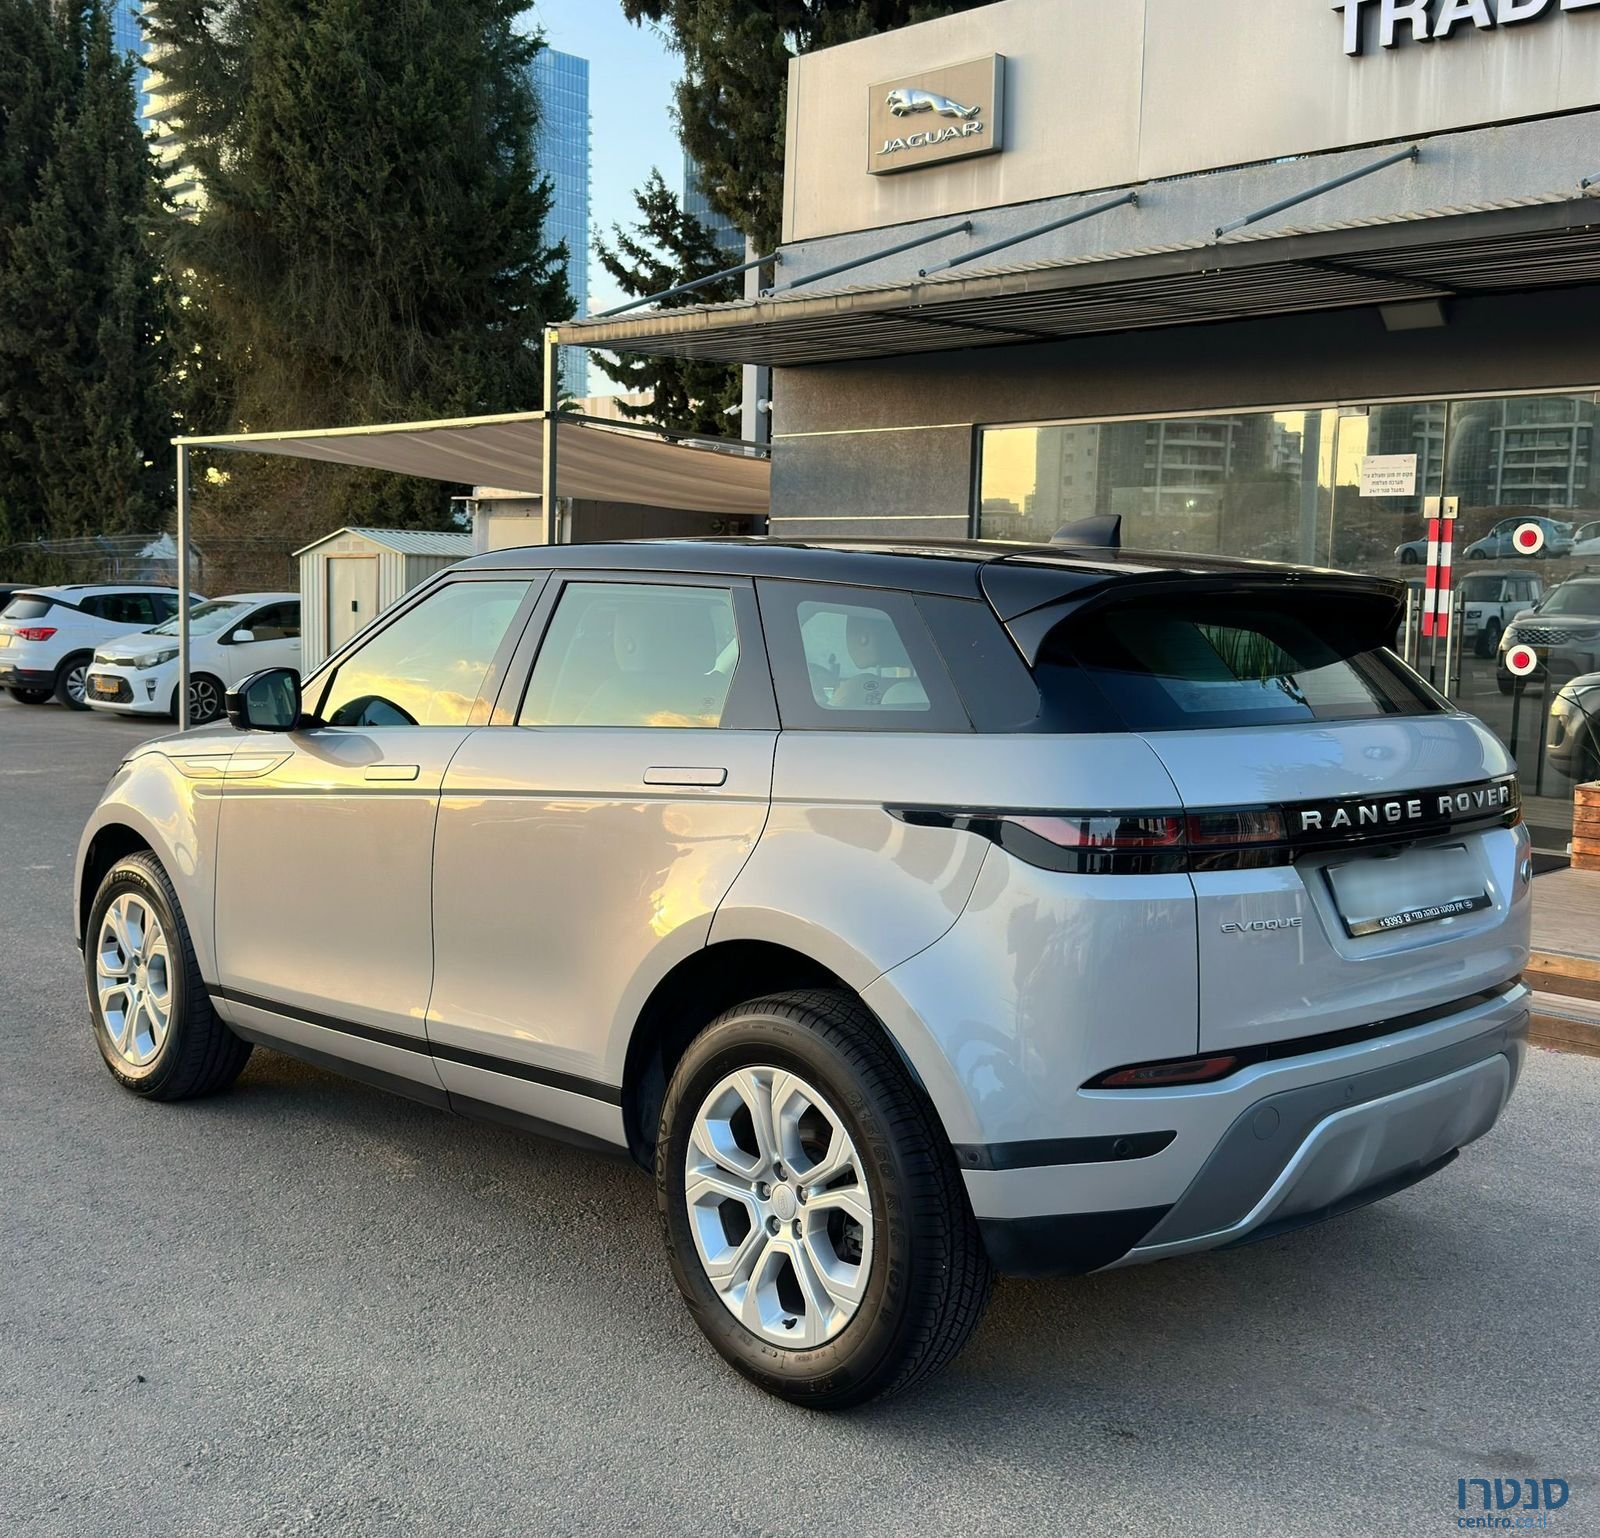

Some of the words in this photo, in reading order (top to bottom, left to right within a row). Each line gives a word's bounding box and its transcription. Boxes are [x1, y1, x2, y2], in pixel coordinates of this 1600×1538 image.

[1331, 0, 1600, 56] TRA
[875, 121, 983, 155] JAGUAR
[1301, 800, 1422, 830] RANGE
[1438, 786, 1509, 814] ROVER
[1221, 917, 1303, 933] EVOQUE
